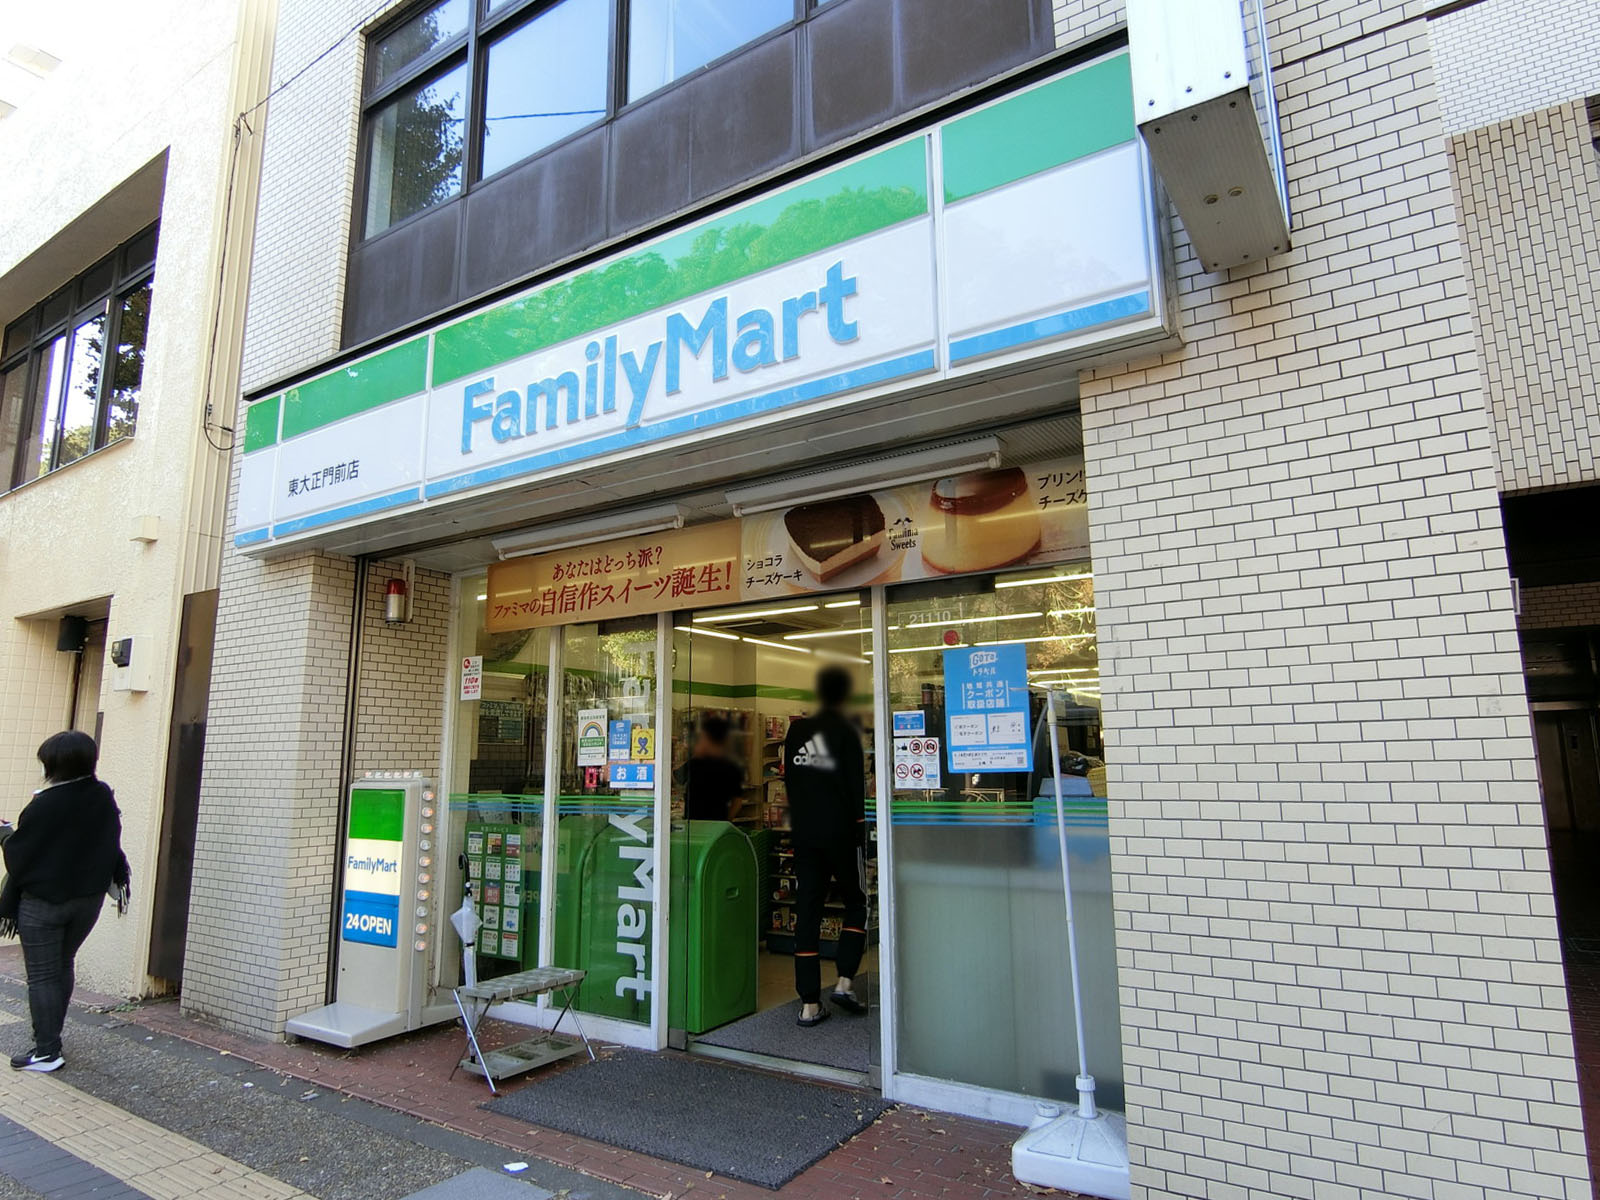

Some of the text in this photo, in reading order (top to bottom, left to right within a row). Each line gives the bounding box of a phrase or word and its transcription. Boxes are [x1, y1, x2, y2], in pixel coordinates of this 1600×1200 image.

[460, 260, 860, 454] FamilyMart
[287, 459, 360, 498] 東大正門前店
[1037, 470, 1083, 490] プリン!
[890, 538, 917, 551] Sweets
[552, 546, 664, 582] あなたはどっち派?
[746, 554, 784, 572] ショコラ
[493, 560, 733, 619] ファミマの自信作スイーツ誕生!
[745, 569, 804, 590] チーズケーキ
[347, 855, 398, 875] FamilyMart
